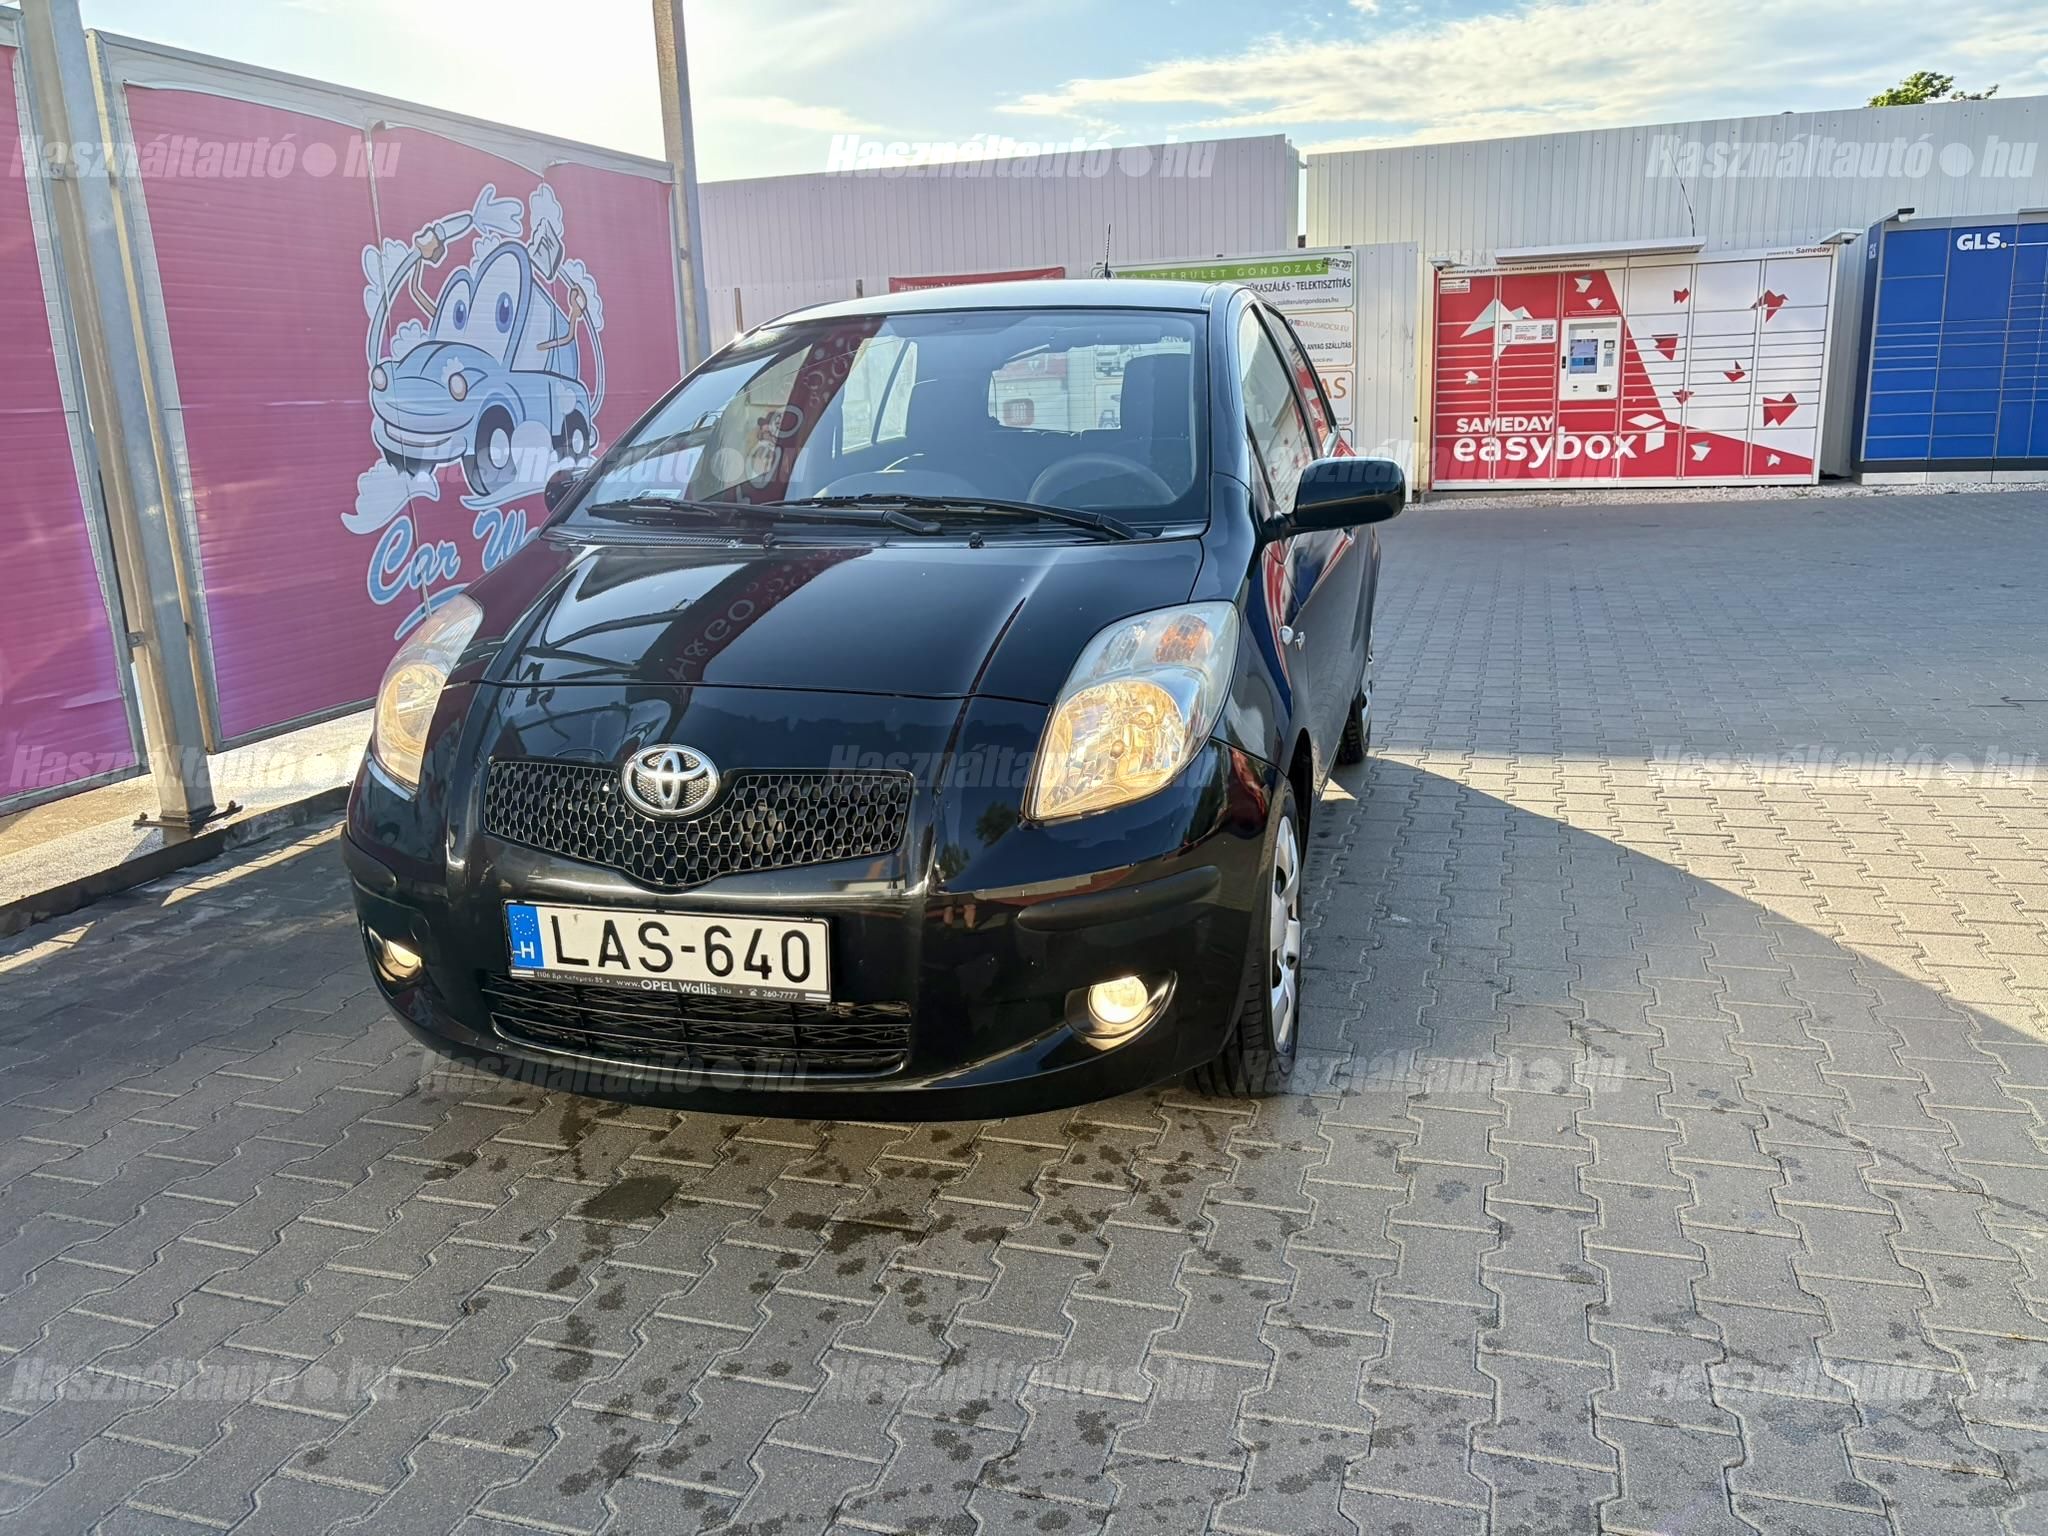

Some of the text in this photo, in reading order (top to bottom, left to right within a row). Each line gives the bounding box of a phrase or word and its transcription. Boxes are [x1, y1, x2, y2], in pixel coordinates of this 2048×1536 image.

[1796, 246, 1831, 255] Sameday
[1296, 278, 1352, 291] TELEKTISZTÍTÁS
[1456, 415, 1554, 433] SAMEDAY
[1453, 426, 1638, 469] easybox
[367, 515, 461, 605] Car
[551, 914, 811, 984] LAS-640
